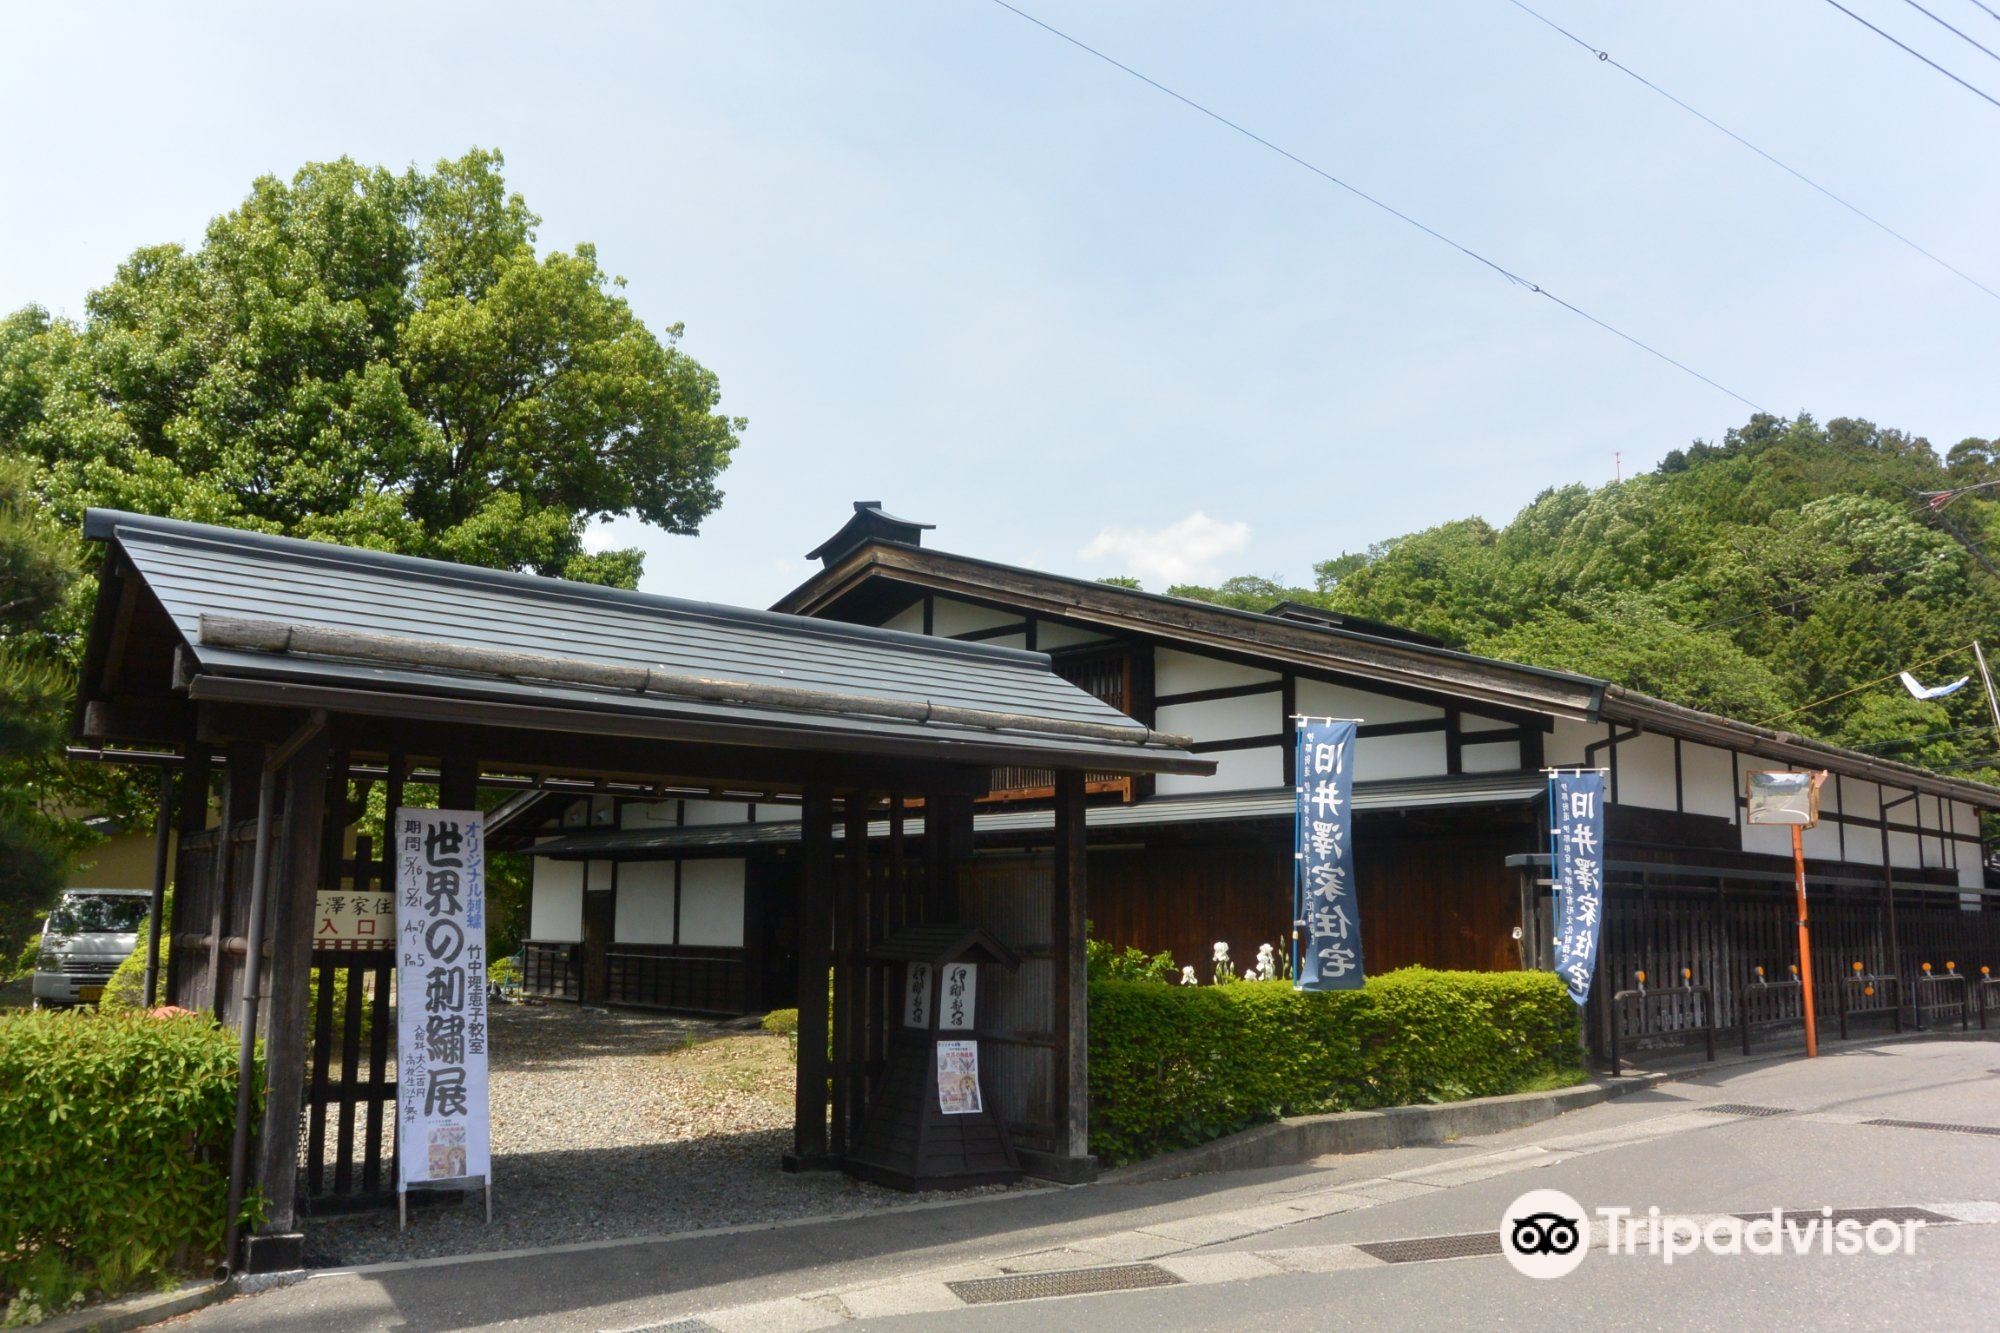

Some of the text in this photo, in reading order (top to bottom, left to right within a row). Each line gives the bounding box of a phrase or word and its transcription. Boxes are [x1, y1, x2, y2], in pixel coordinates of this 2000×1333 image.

[403, 819, 422, 852] 期間
[318, 918, 376, 935] 入口
[424, 820, 468, 1118] 世界の刺繍展
[467, 943, 485, 1055] 竹中理恵子教室
